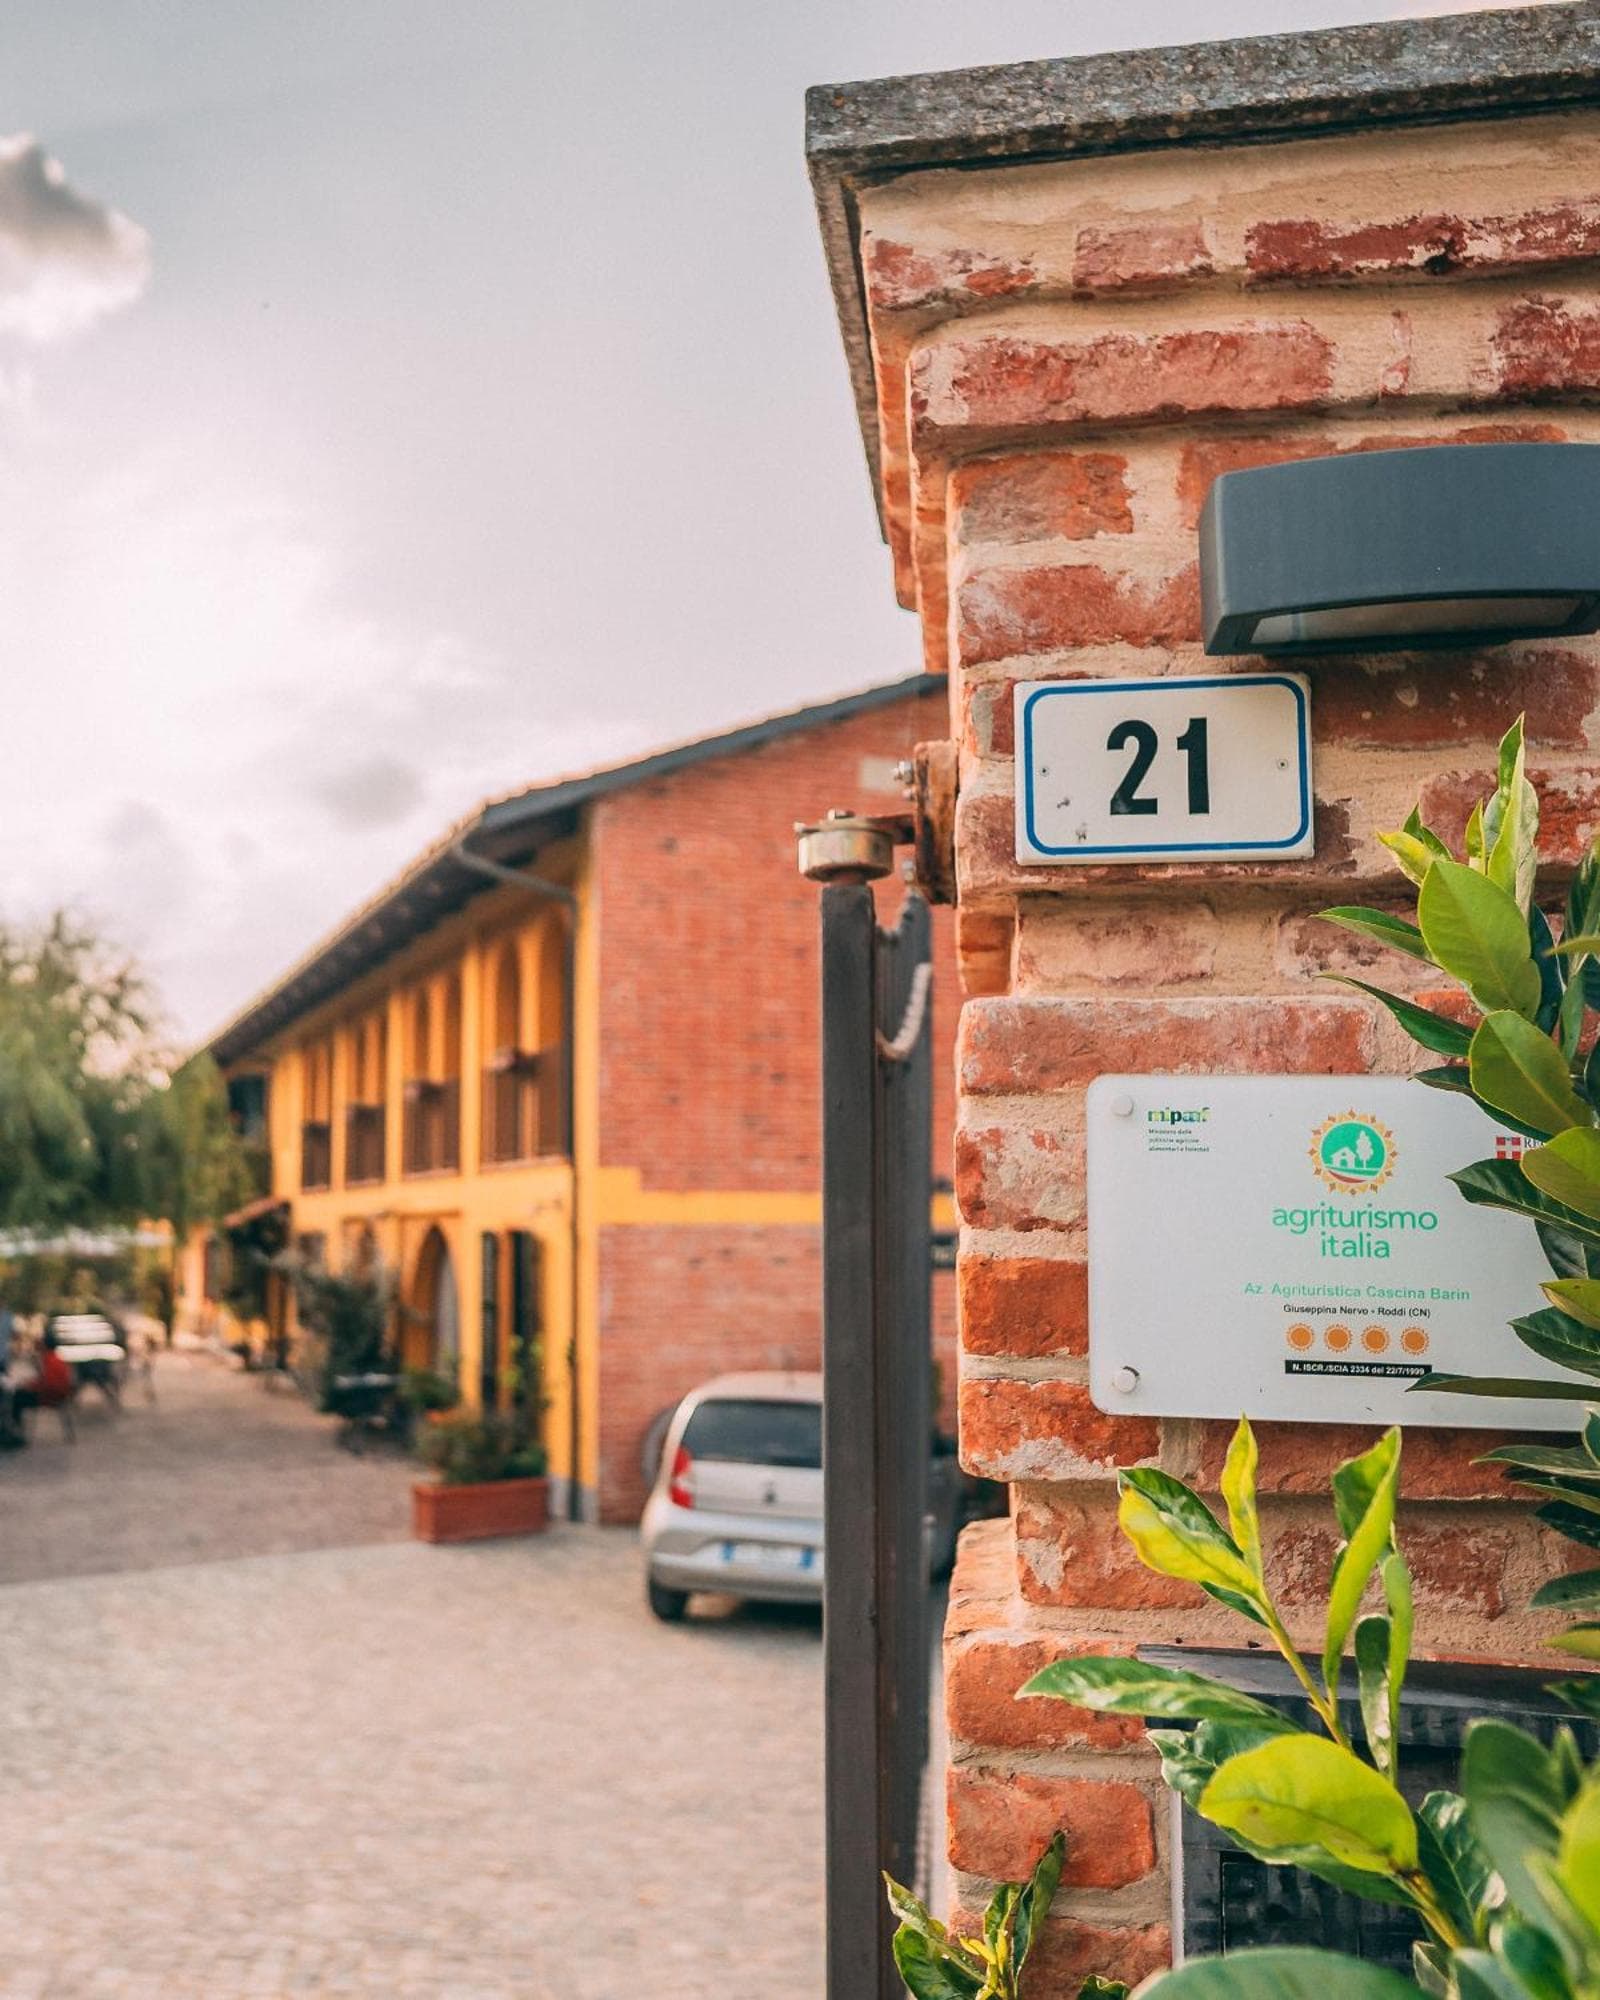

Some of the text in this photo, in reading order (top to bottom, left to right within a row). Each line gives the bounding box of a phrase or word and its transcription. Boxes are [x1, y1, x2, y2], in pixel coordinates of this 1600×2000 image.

[1106, 717, 1210, 816] 21
[1272, 1202, 1438, 1234] agriturismo
[1321, 1231, 1391, 1259] italia
[1271, 1283, 1361, 1299] Agrituristica
[1366, 1285, 1426, 1299] Cascina
[1430, 1287, 1470, 1300] Barin
[1283, 1303, 1337, 1315] Giuseppina
[1339, 1306, 1369, 1316] Nervo
[1377, 1306, 1406, 1317] Roddi
[1408, 1307, 1431, 1319] (CN)
[1292, 1362, 1302, 1372] N.
[1371, 1366, 1385, 1375] del
